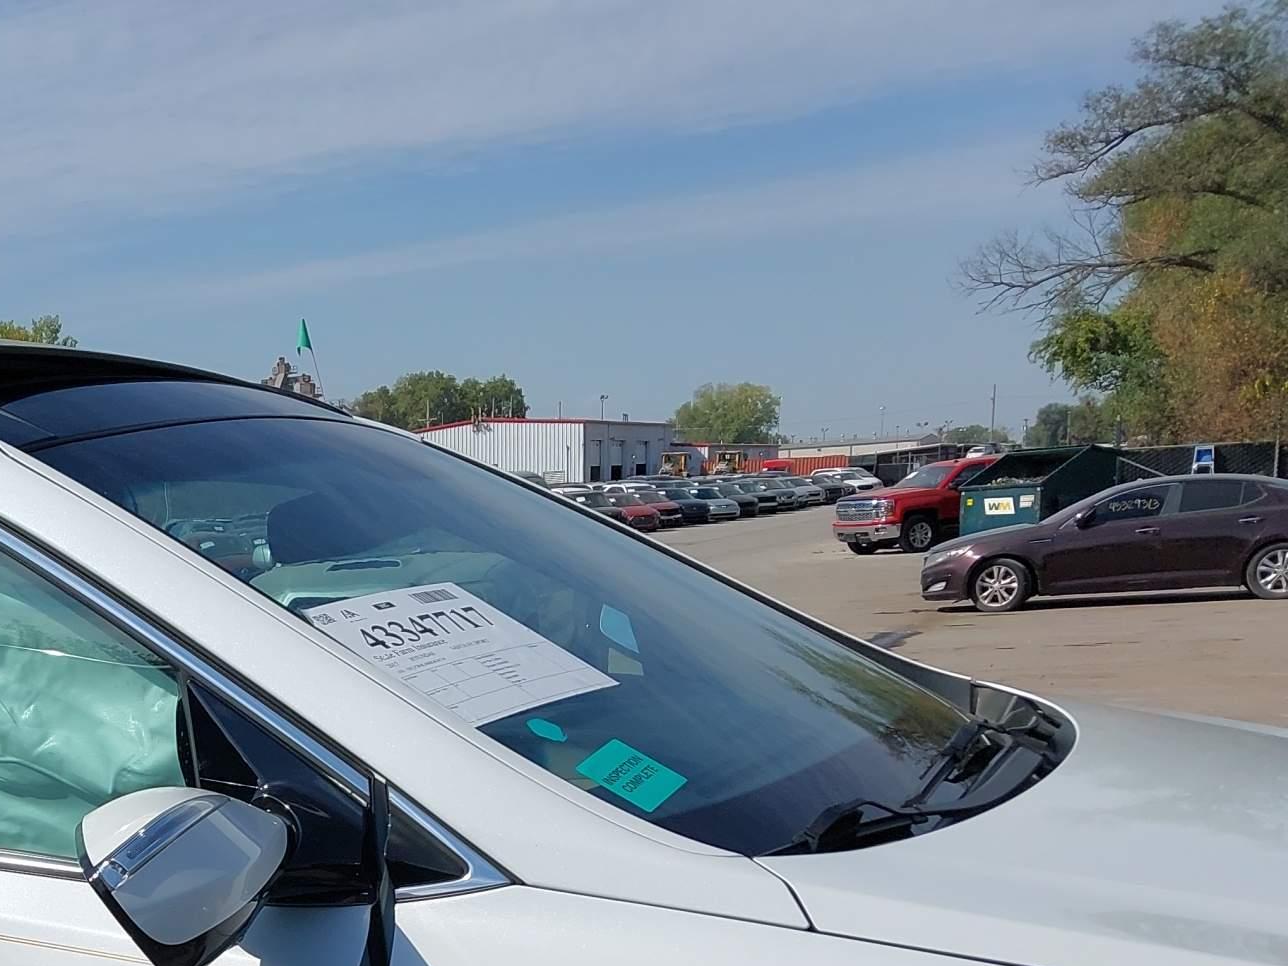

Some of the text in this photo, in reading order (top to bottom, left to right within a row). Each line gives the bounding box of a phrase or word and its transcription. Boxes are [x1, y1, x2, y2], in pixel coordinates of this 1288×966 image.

[988, 502, 1011, 511] WM
[360, 606, 494, 649] 43347717
[601, 754, 643, 786] INSPECTION
[622, 764, 659, 793] COMPLETE
